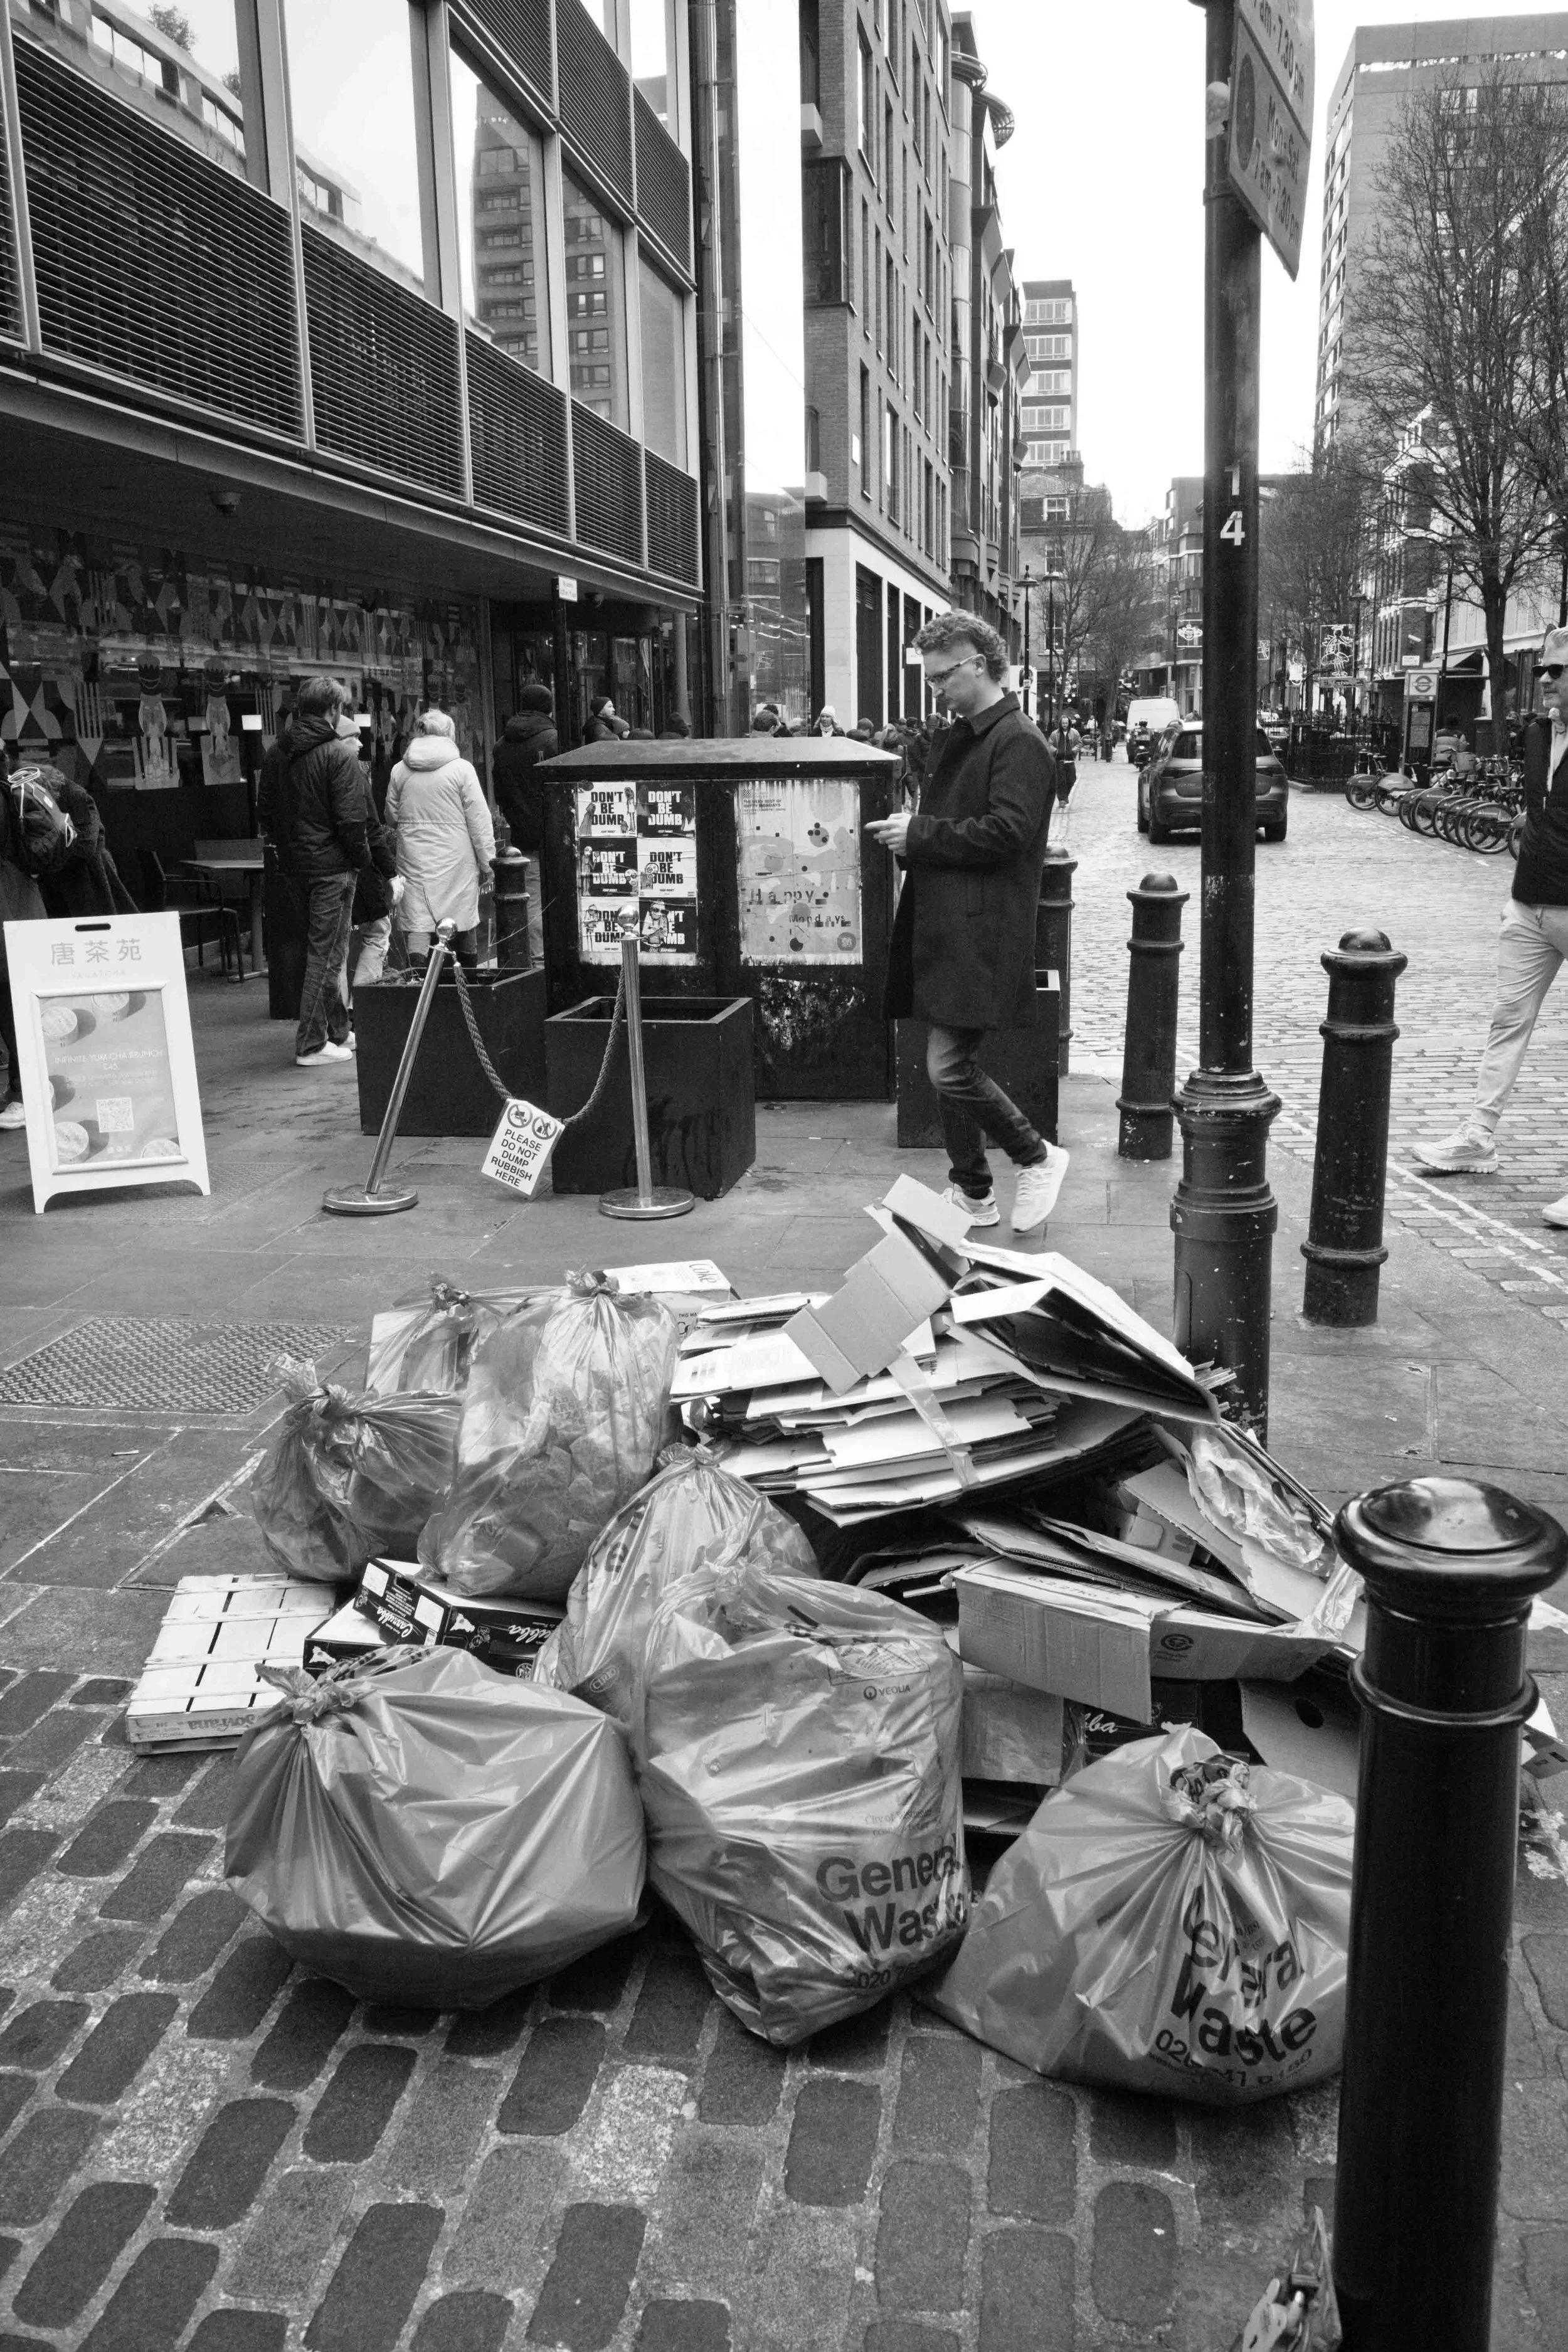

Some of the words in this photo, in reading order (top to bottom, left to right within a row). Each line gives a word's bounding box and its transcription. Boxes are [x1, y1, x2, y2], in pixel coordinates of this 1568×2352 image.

[591, 792, 623, 802] DON'T
[648, 791, 682, 803] DON'T
[600, 803, 614, 813] BE
[658, 803, 672, 814] BE
[591, 814, 625, 825] DUMB
[648, 813, 682, 825] DUMB
[650, 852, 682, 862] DON'T
[602, 862, 617, 873] BE
[660, 862, 673, 872] BE
[592, 872, 627, 884] DUMB
[595, 932, 623, 943] DUM
[51, 938, 142, 965] 唐茶苑
[505, 1129, 542, 1152] PLEASE
[502, 1139, 516, 1150] DO
[517, 1147, 538, 1160] NOT
[502, 1150, 529, 1167] DUMP
[491, 1156, 532, 1181] RUBBISH
[495, 1169, 521, 1187] HERE
[689, 1264, 718, 1283] Coke
[878, 1685, 911, 1696] VEOLIA
